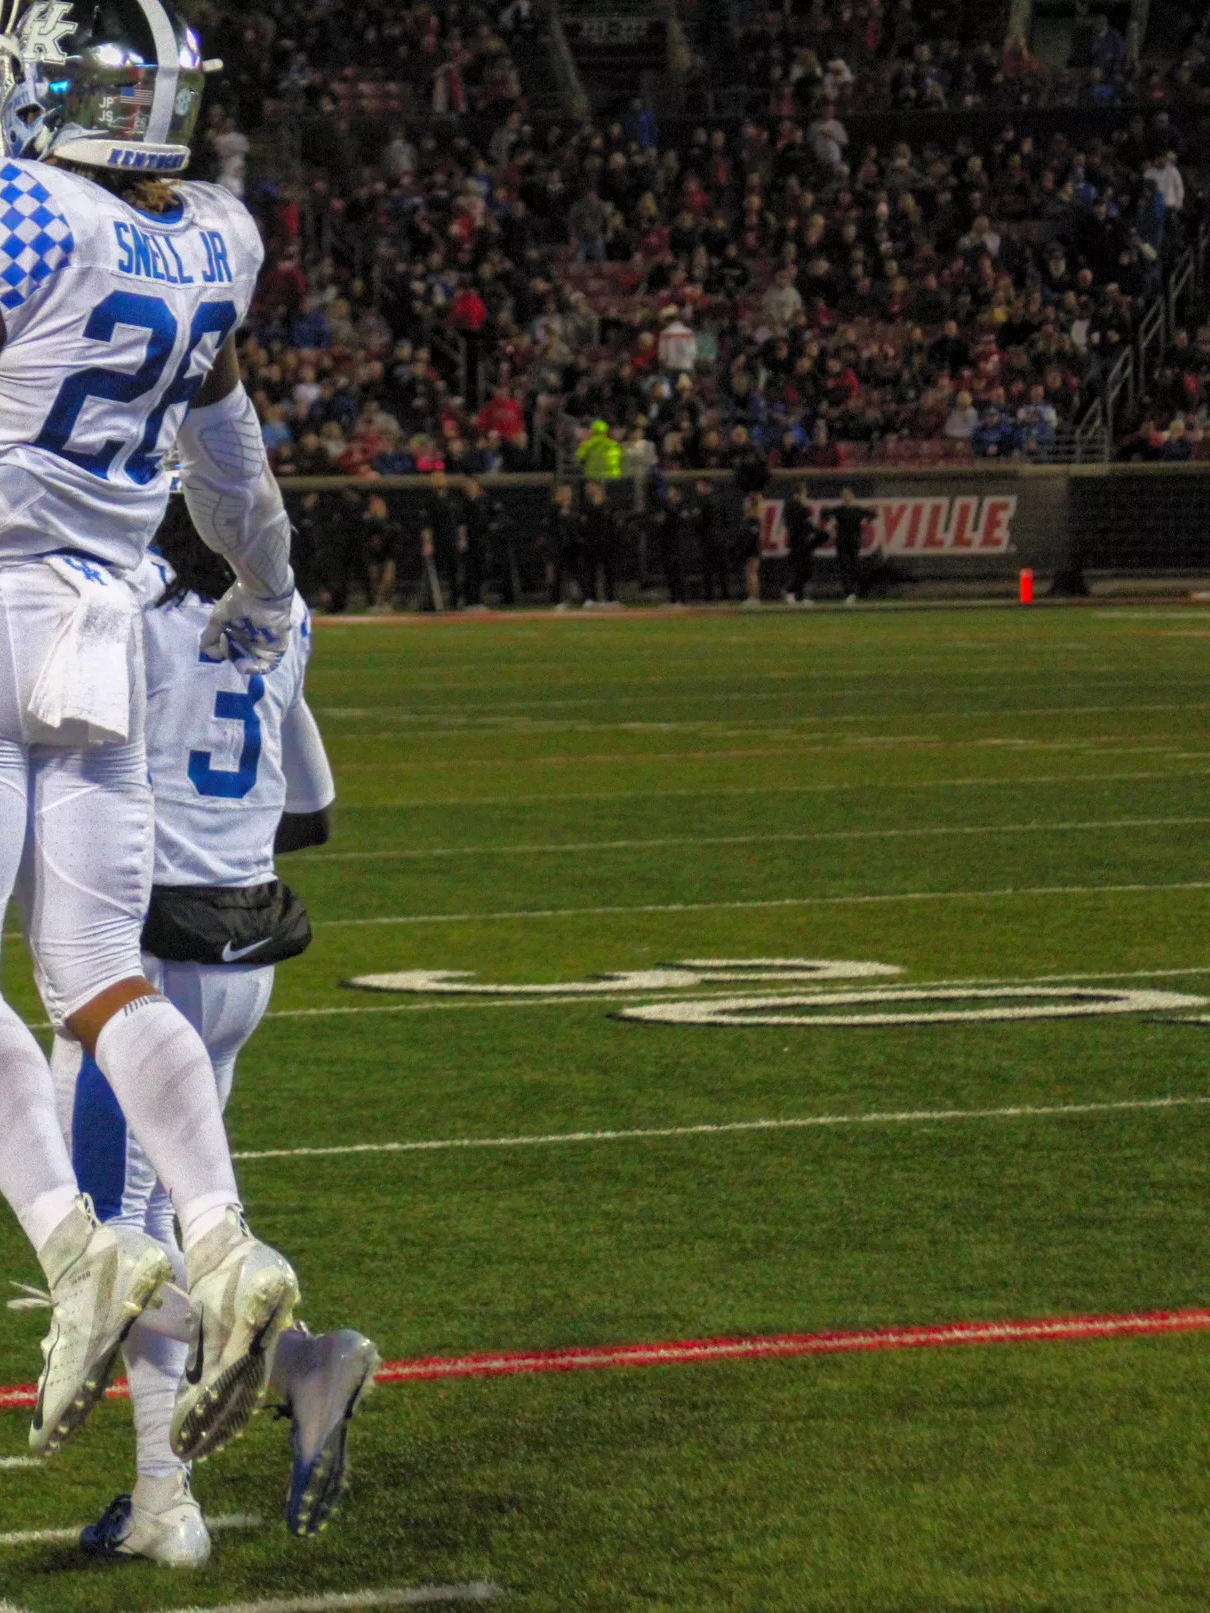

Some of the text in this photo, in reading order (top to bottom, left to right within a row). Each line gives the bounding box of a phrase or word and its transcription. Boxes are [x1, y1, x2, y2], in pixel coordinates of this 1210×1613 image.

[98, 110, 114, 122] JS
[99, 96, 114, 109] JP
[113, 220, 233, 284] SNELL JR
[187, 646, 266, 799] 3
